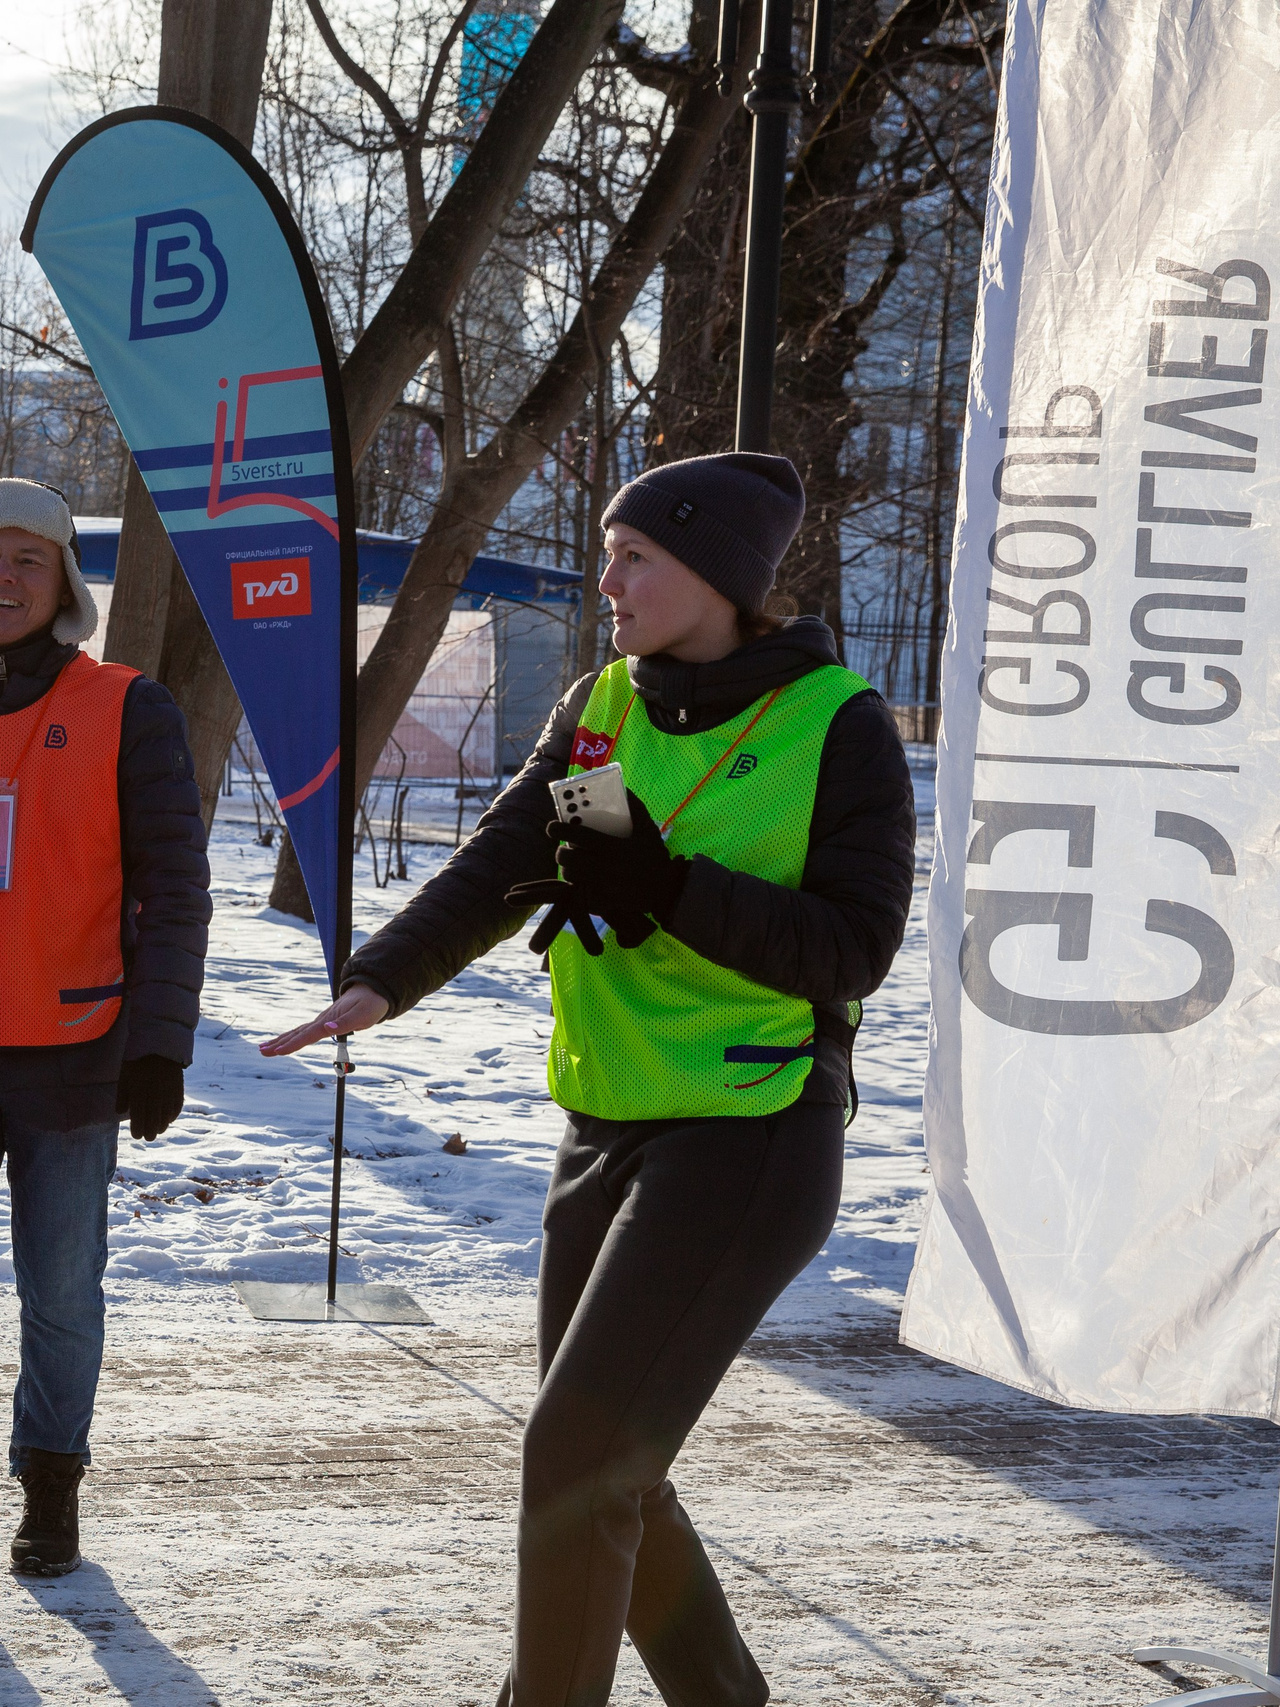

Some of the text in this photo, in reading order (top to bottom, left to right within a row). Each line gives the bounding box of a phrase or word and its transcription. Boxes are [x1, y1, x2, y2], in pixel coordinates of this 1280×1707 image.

[231, 461, 304, 482] 5verst.ru
[225, 545, 314, 560] ОФИЦИАЛЬНЫЙ ПАРТНЕР
[253, 622, 267, 630] ОАО
